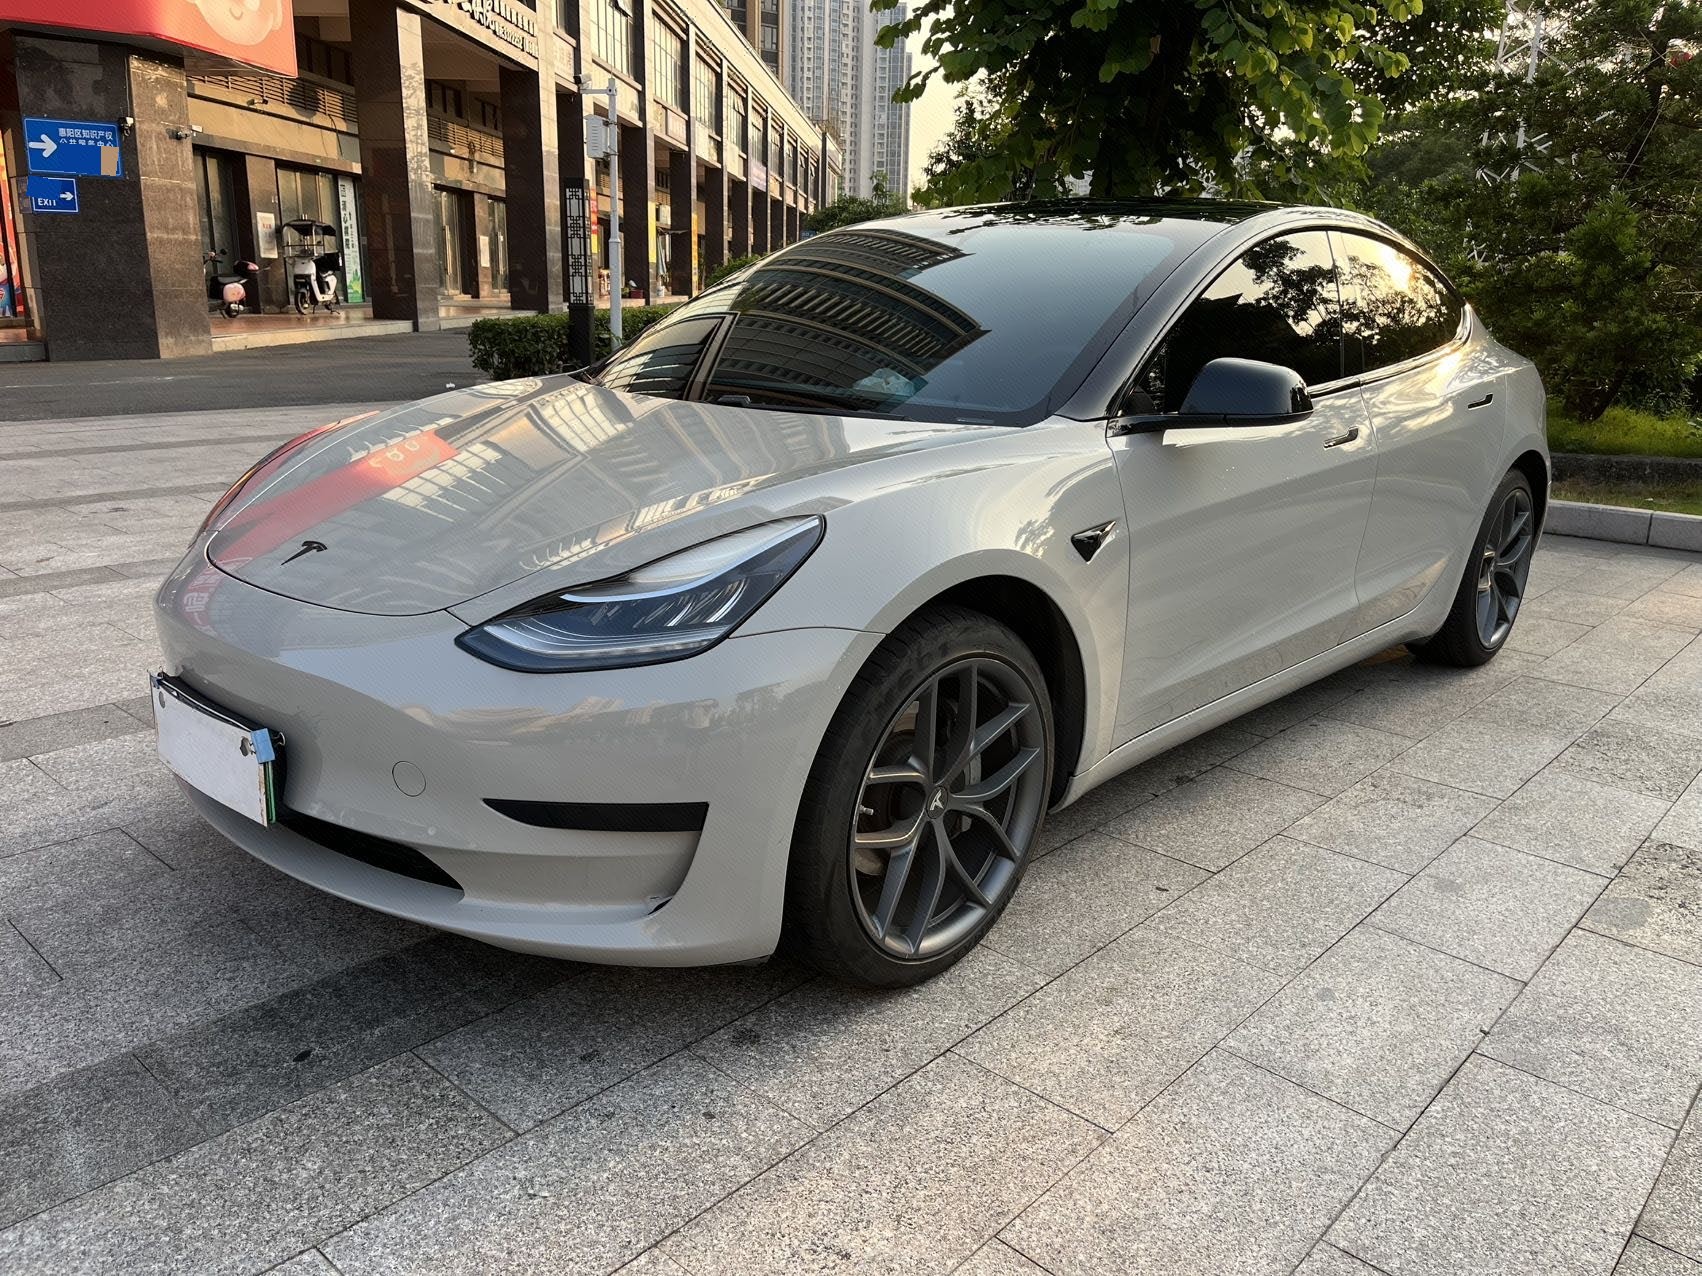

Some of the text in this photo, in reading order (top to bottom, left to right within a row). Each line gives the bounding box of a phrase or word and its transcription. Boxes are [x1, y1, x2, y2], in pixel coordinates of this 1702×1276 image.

[58, 128, 113, 140] 惠阳区知识产权
[38, 198, 56, 206] EXIT
